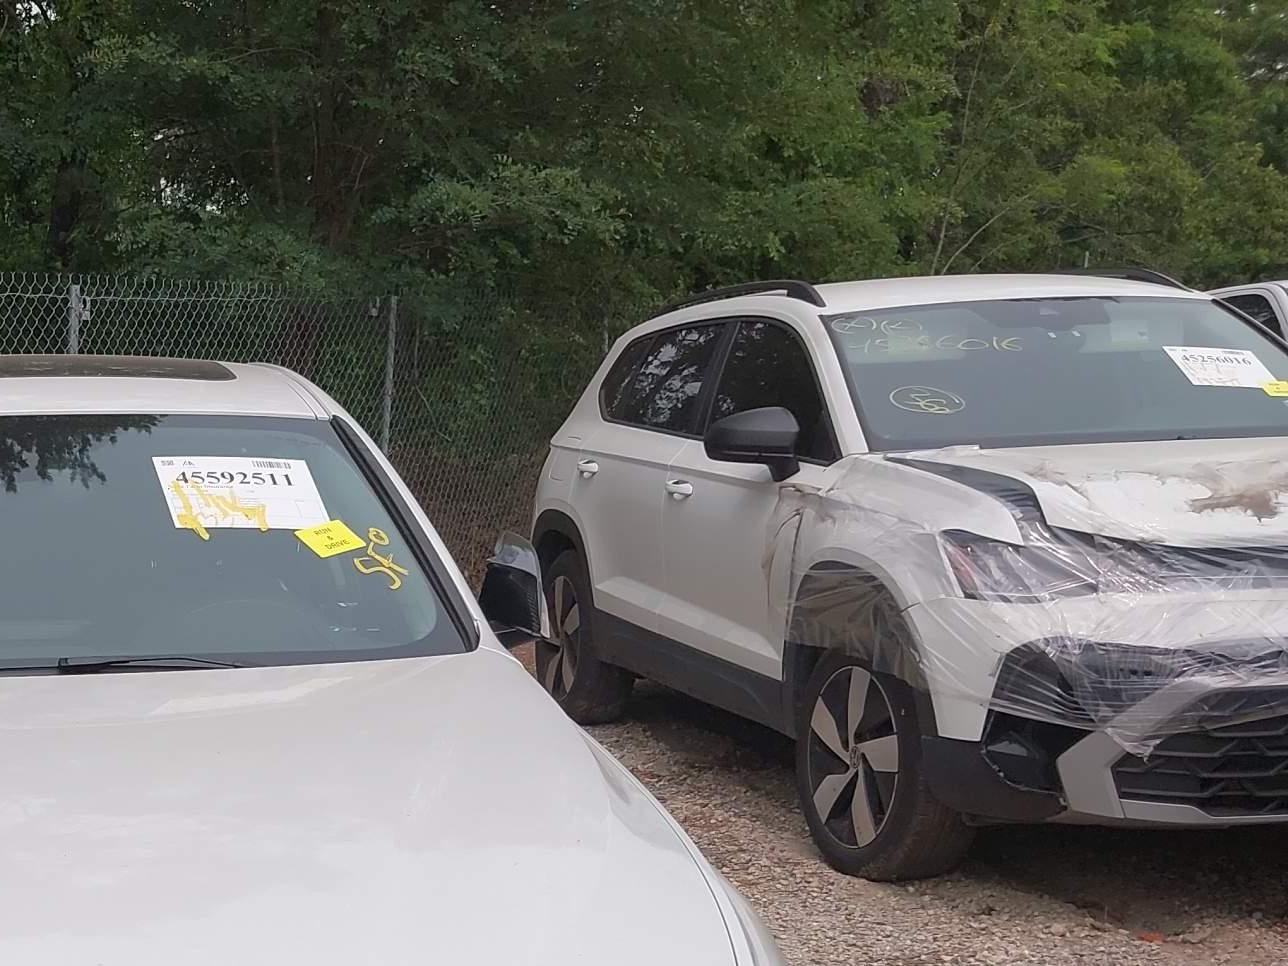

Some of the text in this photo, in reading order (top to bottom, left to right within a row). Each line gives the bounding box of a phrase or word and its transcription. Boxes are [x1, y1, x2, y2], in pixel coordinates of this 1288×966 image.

[175, 470, 295, 487] 45592511
[314, 527, 332, 536] RUN
[324, 539, 350, 550] DRIVE
